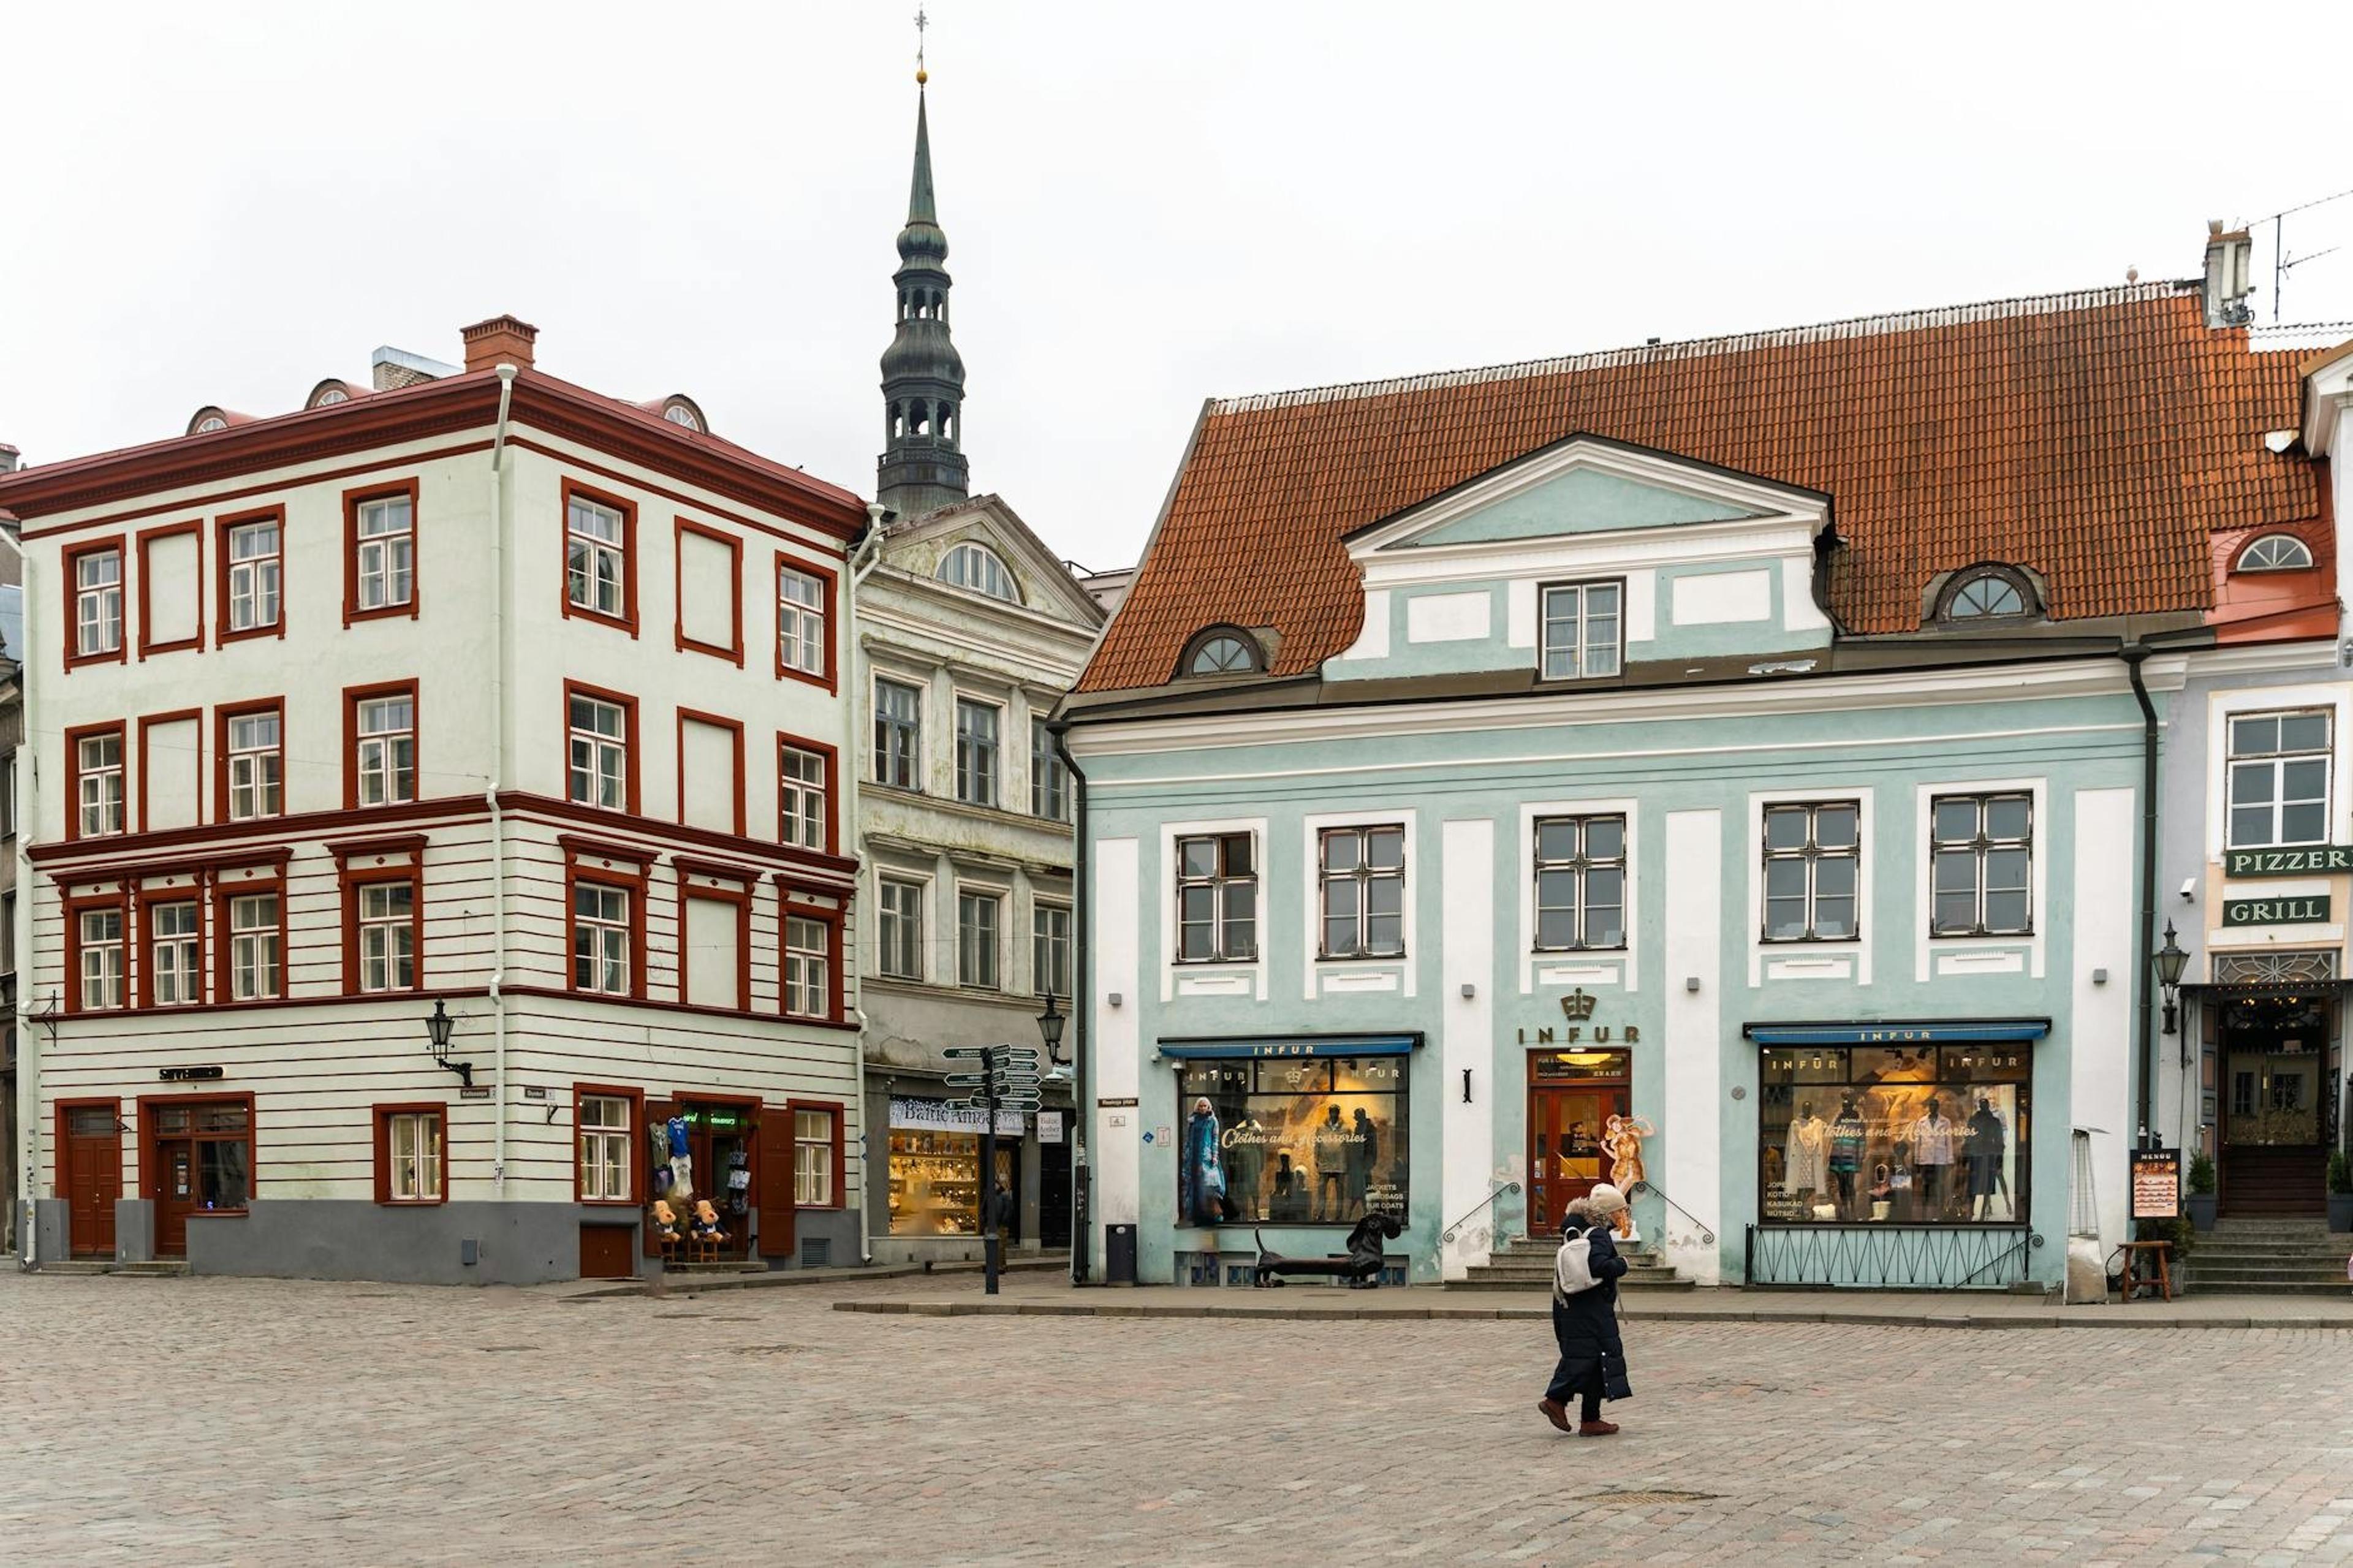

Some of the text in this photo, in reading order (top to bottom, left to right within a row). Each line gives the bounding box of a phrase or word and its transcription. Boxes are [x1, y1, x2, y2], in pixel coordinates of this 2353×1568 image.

[2234, 850, 2353, 872] PIZZER
[2230, 901, 2322, 922] GRILL
[1518, 1026, 1640, 1045] INFUR
[1860, 1031, 1930, 1041] INFUR
[1253, 1045, 1314, 1055] INFUR
[1772, 1060, 1837, 1070] INFUR
[1950, 1057, 2017, 1067] INFUR
[1189, 1071, 1245, 1081] INFUR
[1342, 1069, 1400, 1078] NFUR
[1221, 1128, 1267, 1149] Clothes
[1269, 1131, 1294, 1144] and
